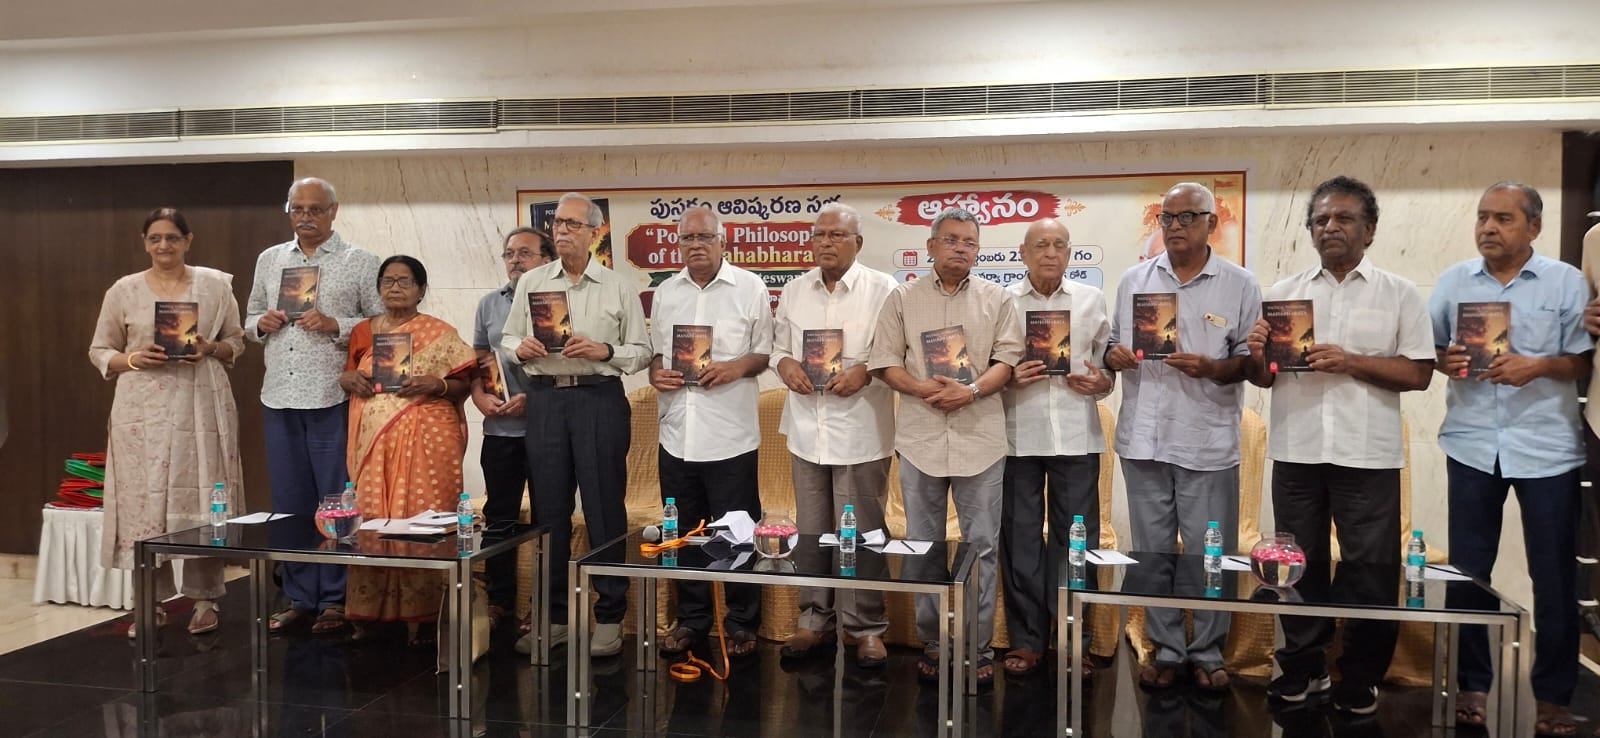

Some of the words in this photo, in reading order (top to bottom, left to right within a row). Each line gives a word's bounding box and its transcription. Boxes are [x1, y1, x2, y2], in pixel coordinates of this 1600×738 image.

[717, 196, 802, 220] ఆవిష్కరణ
[733, 226, 815, 246] Philosop
[648, 247, 667, 264] of
[670, 247, 684, 264] th
[722, 245, 815, 264] ahabhara
[1074, 250, 1092, 261] గం
